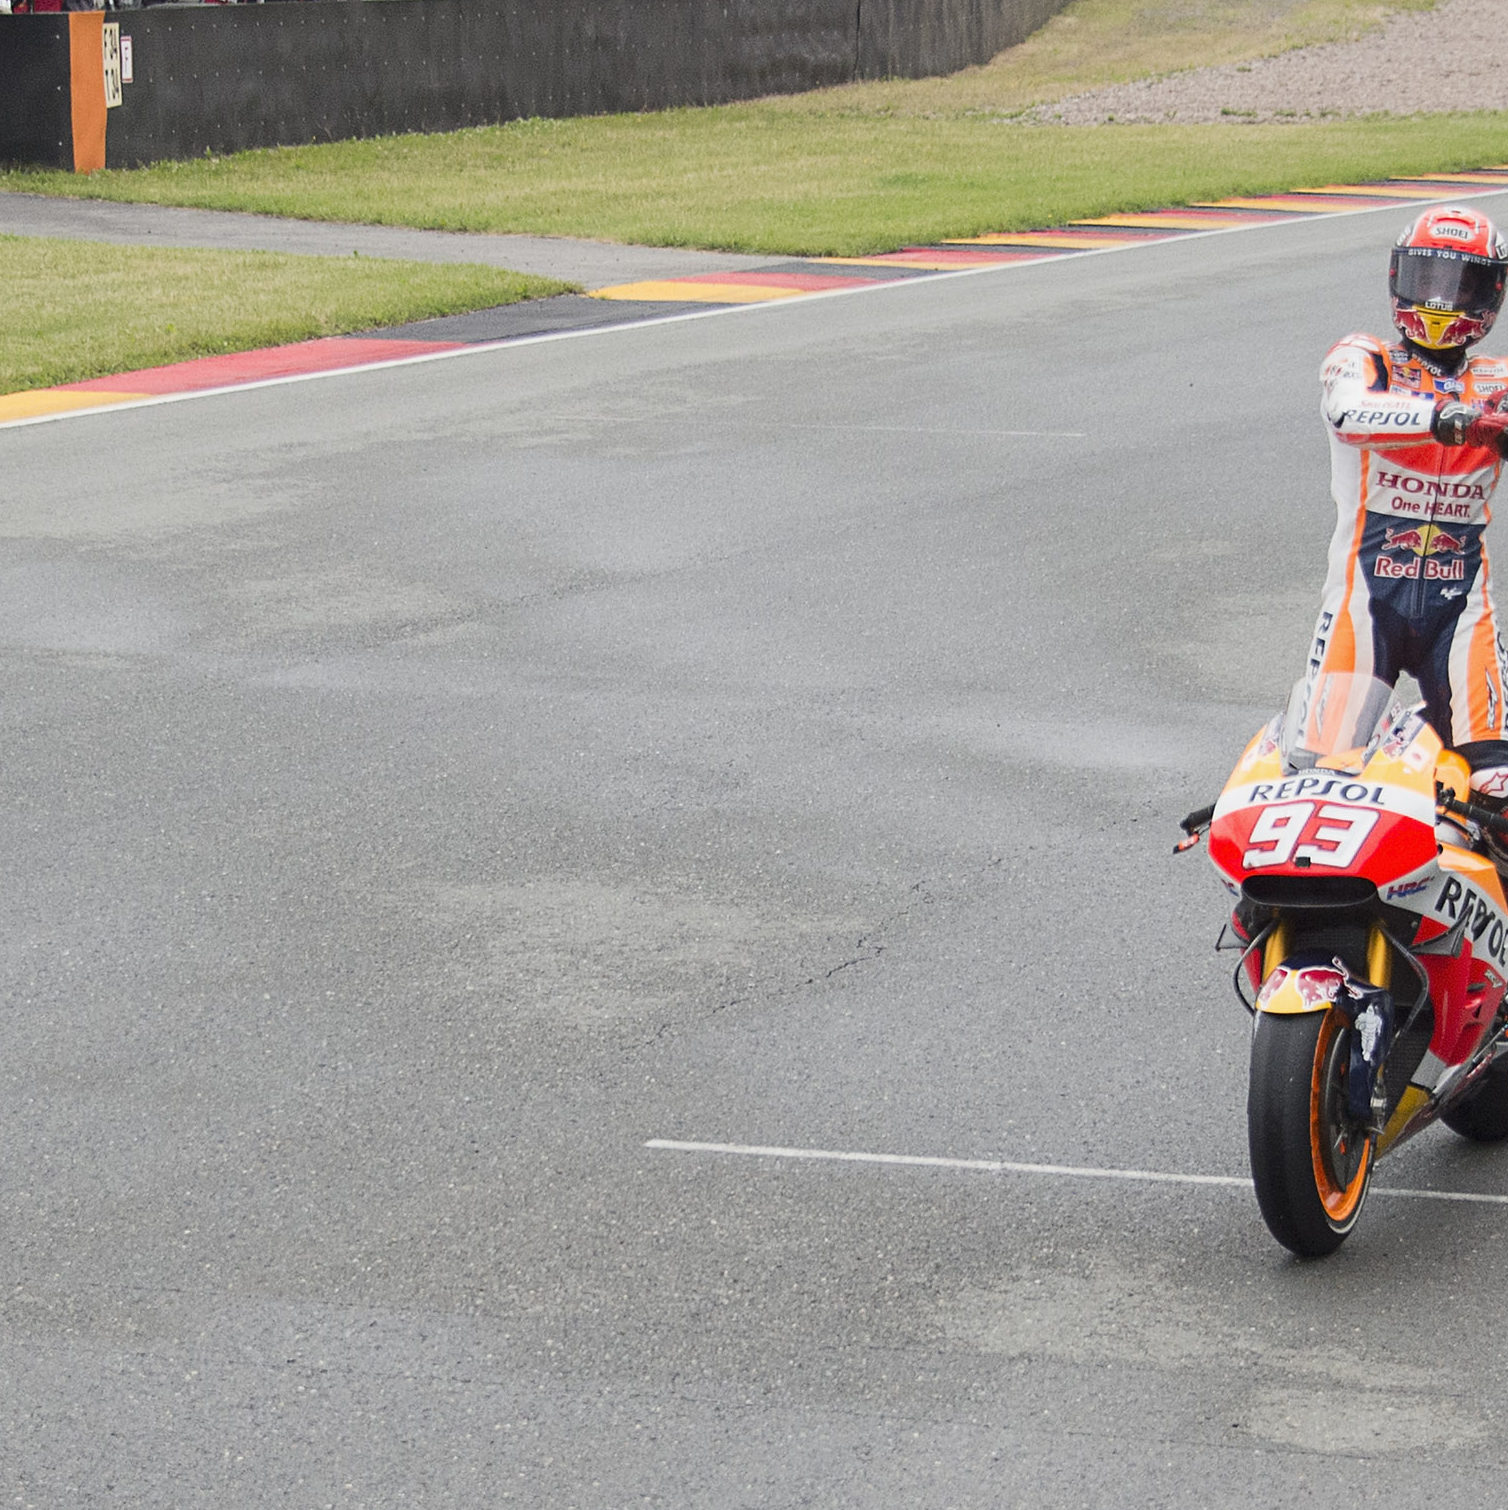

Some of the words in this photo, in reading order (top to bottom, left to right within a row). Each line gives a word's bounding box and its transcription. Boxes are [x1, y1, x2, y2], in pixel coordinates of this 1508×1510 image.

[1435, 226, 1469, 240] SHOEI
[1408, 248, 1432, 257] GIVES
[1436, 250, 1457, 260] YOU
[1425, 300, 1454, 312] LOTUS
[1346, 409, 1421, 426] REPSOL
[1376, 471, 1486, 500] HONDA
[1391, 496, 1420, 513] One
[1374, 555, 1421, 579] Red
[1423, 559, 1465, 580] Bull
[1248, 777, 1385, 805] REPSOL
[1241, 800, 1380, 871] 93
